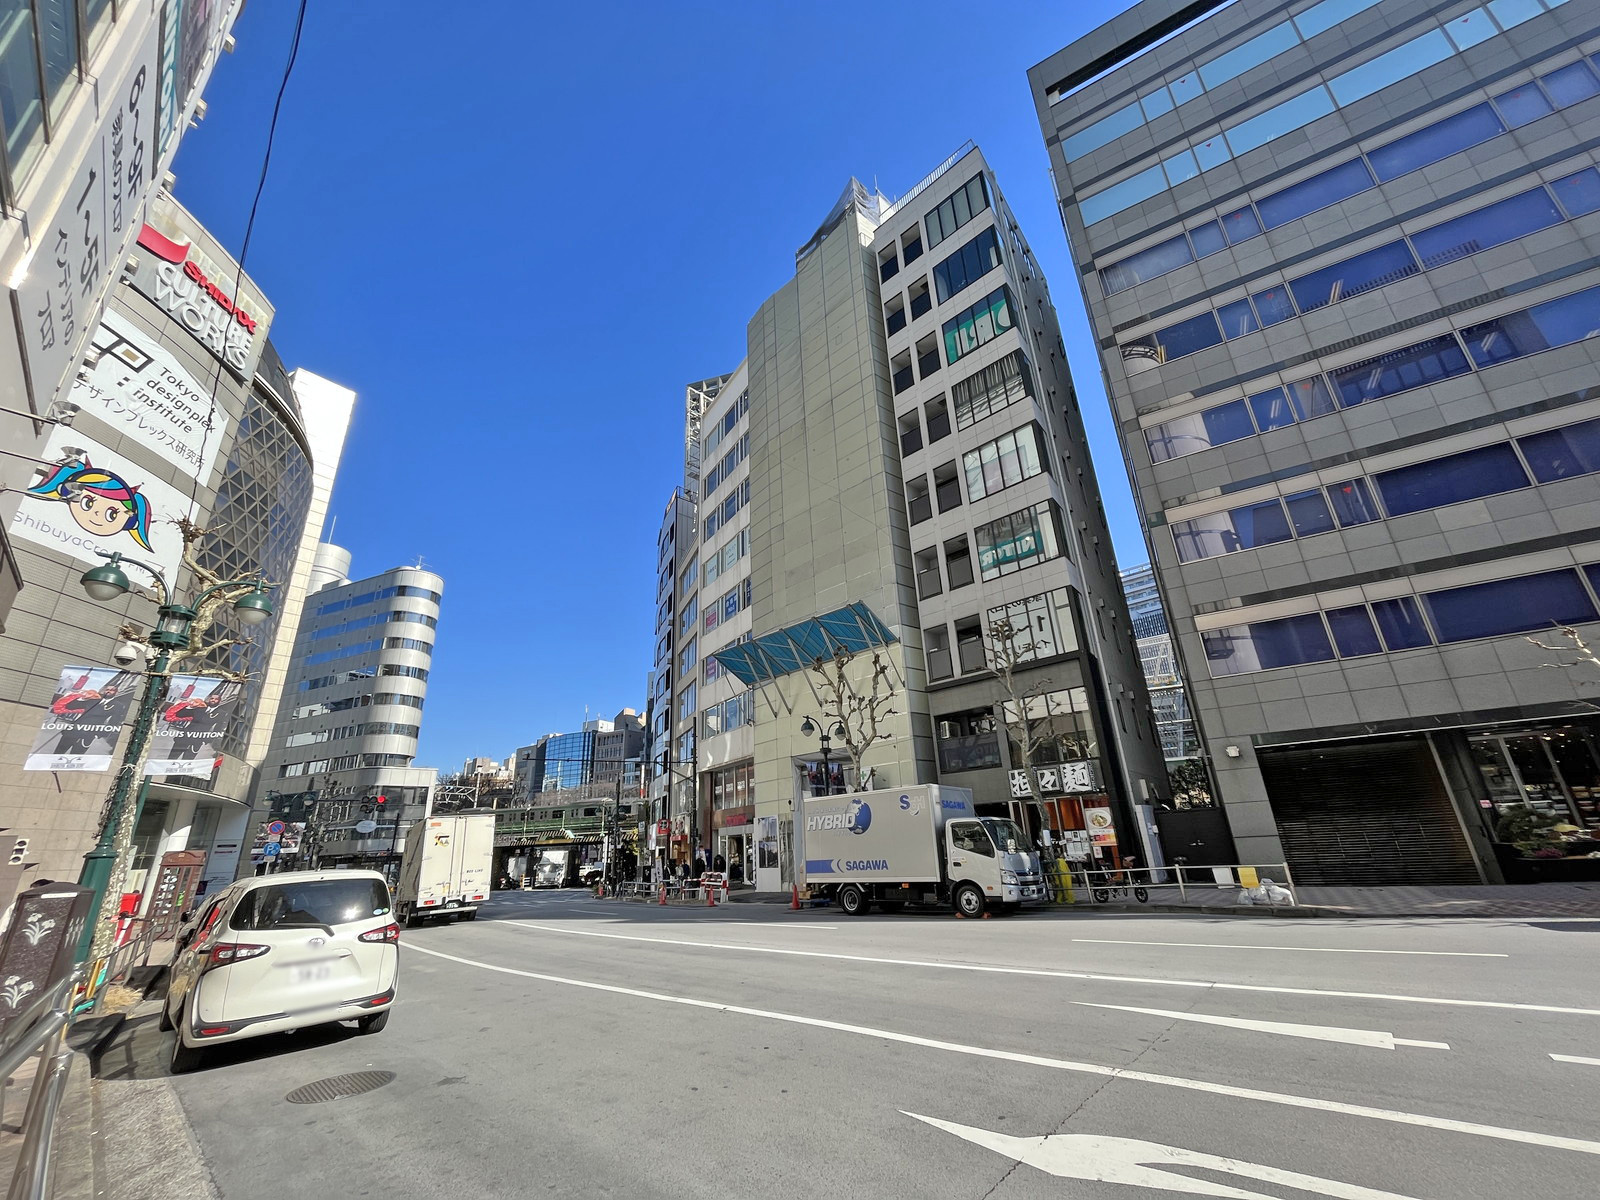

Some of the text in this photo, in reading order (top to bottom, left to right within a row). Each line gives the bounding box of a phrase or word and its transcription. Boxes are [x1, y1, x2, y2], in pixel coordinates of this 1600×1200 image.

[111, 105, 124, 233] 家具のフロア
[55, 227, 75, 346] インテリアの
[158, 261, 254, 358] CULTURE
[38, 289, 55, 352] フロア
[154, 275, 246, 371] WORKS
[146, 379, 216, 434] designplex
[160, 366, 200, 402] Tokyo
[133, 388, 192, 434] institute
[41, 723, 122, 732] LOUIS VUITTON
[155, 730, 225, 739] LOUIS VUITTON
[807, 812, 856, 832] HYBRID
[941, 800, 967, 810] SAGAWA
[845, 859, 889, 871] SAGAWA
